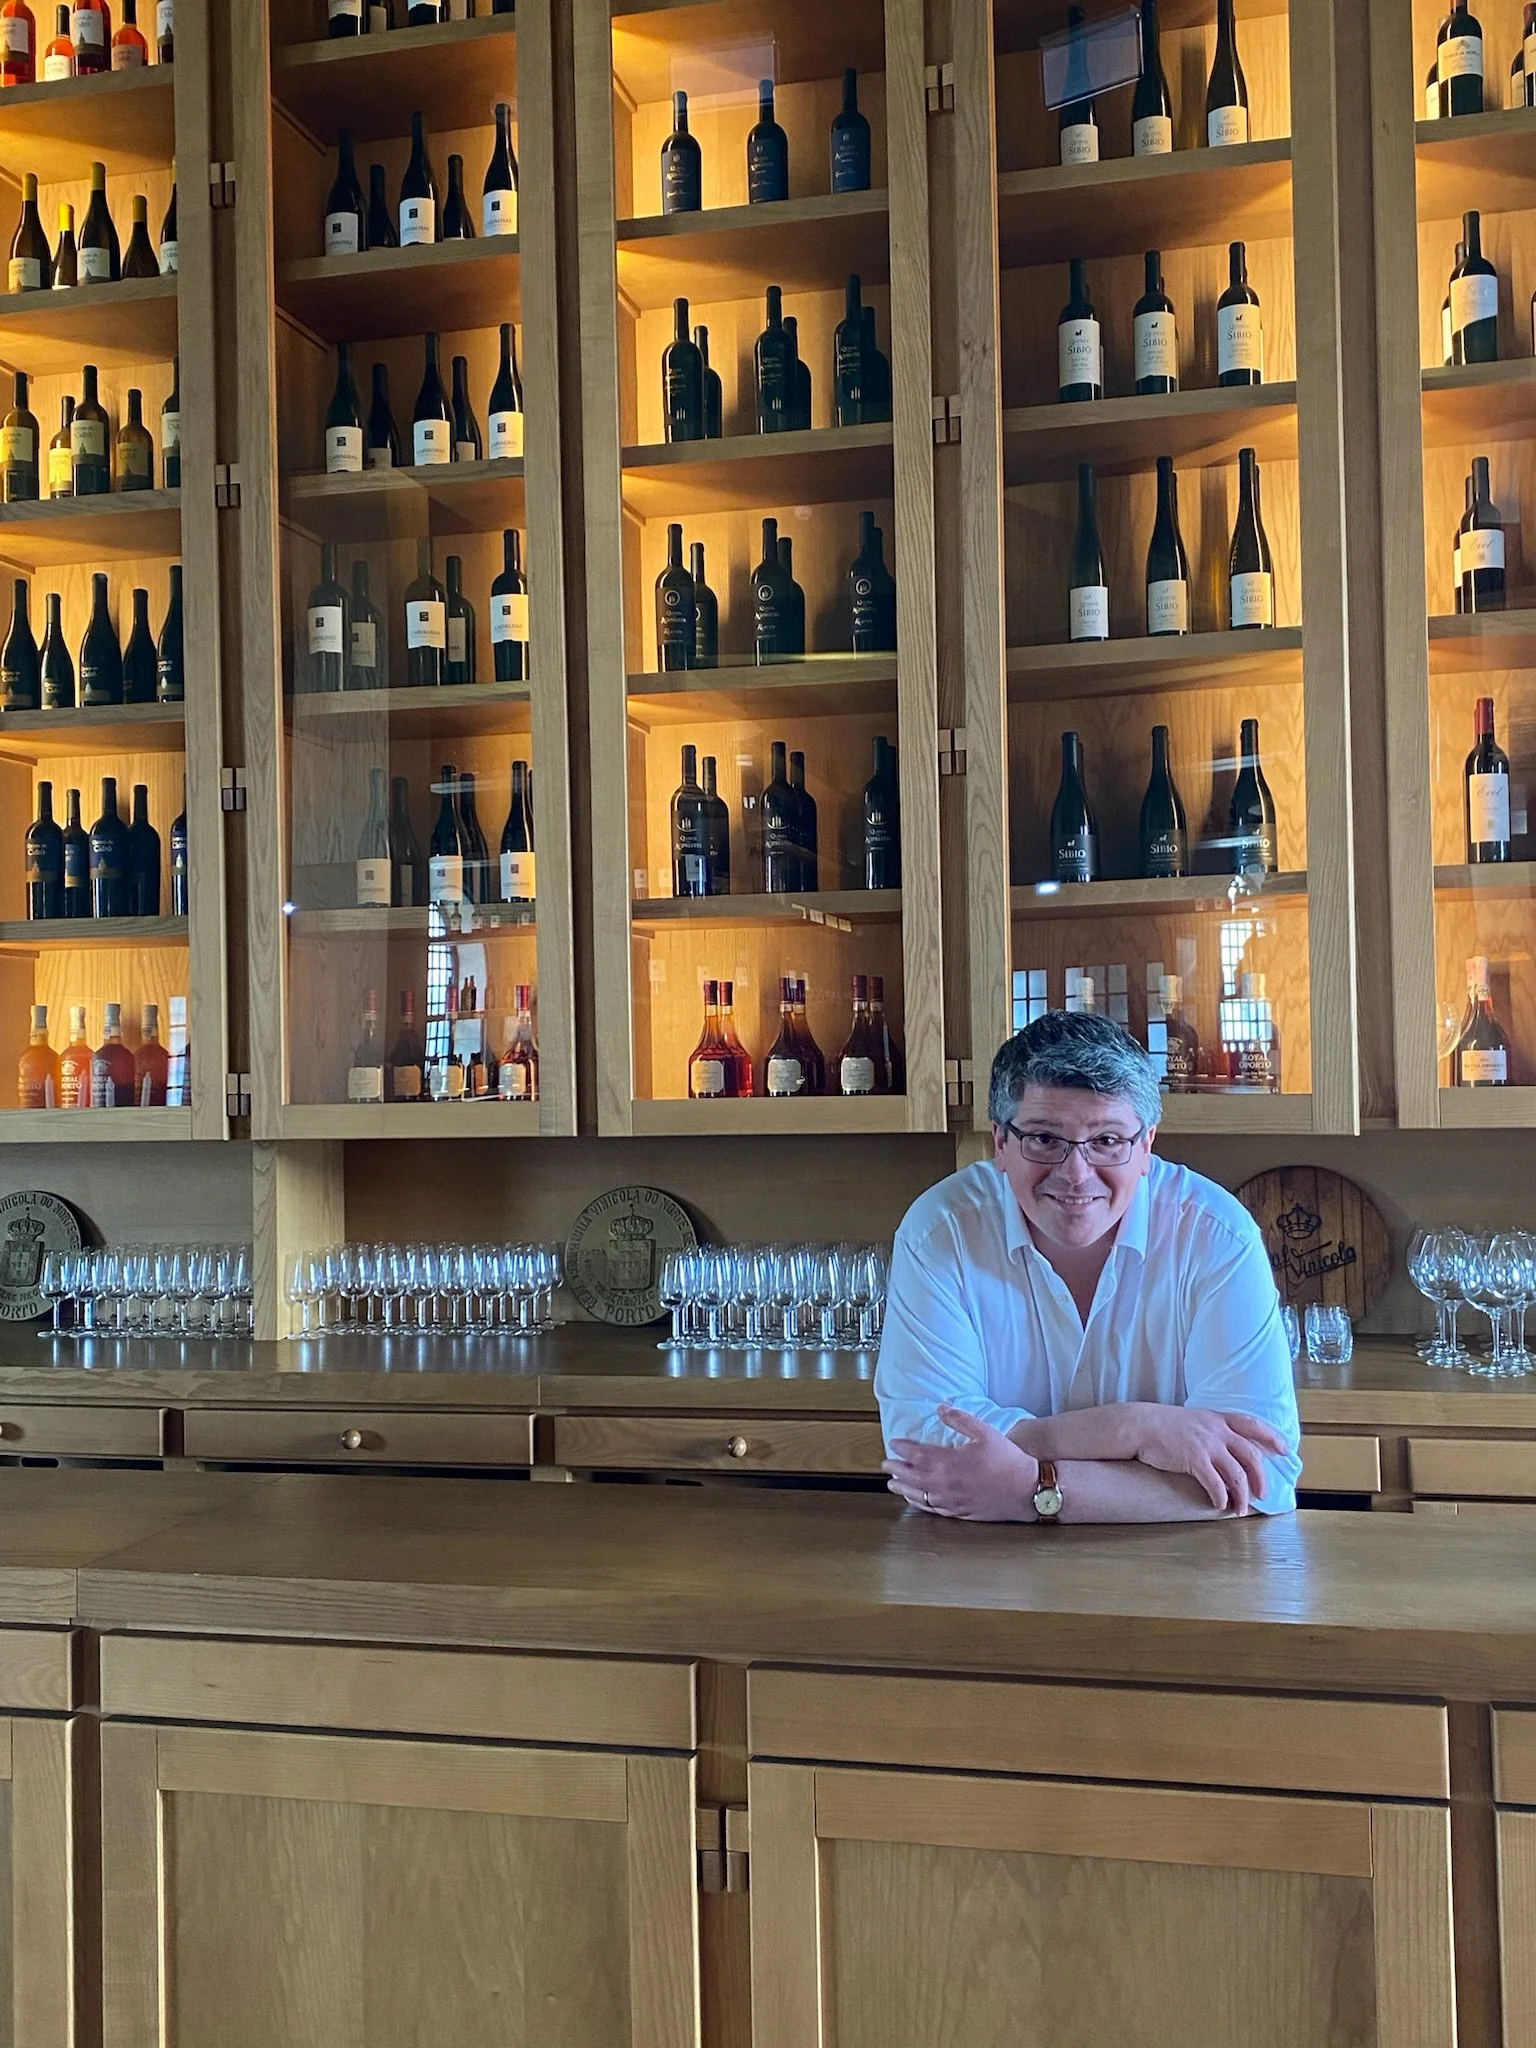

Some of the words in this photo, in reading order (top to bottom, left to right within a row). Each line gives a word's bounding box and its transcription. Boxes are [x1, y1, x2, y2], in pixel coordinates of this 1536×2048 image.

[1227, 330, 1252, 341] SIBIO
[1142, 337, 1168, 349] SIBIO
[1067, 344, 1092, 356] SIBIO
[1240, 594, 1264, 605] SIBIO
[1078, 607, 1101, 618] SIBIO
[1155, 602, 1179, 612] SIBIO
[1058, 849, 1087, 860] SIBIO
[1150, 844, 1178, 856] SIBIO
[1239, 1060, 1272, 1069] OPORTO
[40, 1196, 54, 1209] DO
[52, 1202, 77, 1235] NORTE
[644, 1190, 659, 1204] DO
[660, 1198, 690, 1231] NORTE
[604, 1303, 657, 1323] PORTO
